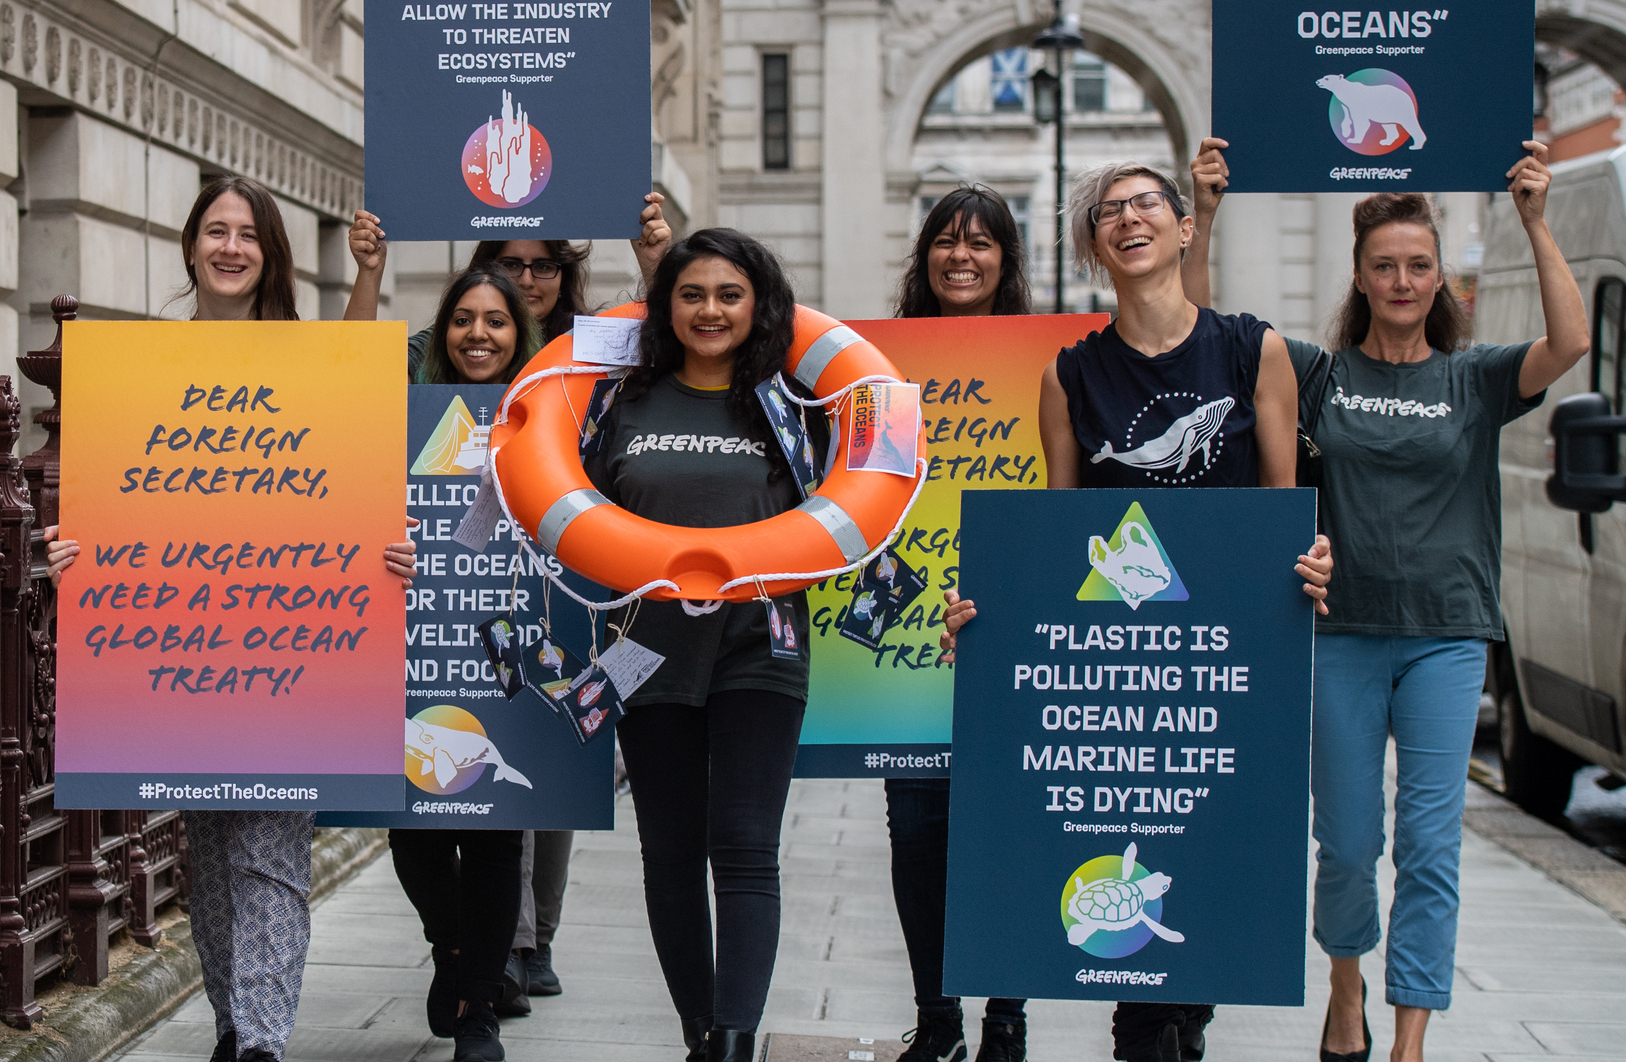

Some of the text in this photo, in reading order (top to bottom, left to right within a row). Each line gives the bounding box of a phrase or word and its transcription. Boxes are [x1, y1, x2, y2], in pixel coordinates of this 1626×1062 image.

[402, 2, 612, 20] ALLOW THE INDUSTRY
[1298, 10, 1448, 38] OCEANS”
[443, 28, 569, 44] TO THREATEN
[438, 51, 575, 69] ECOSYSTEMS”
[1315, 44, 1425, 57] Greenpeace Supporter
[456, 74, 553, 85] Greenpeace Supporter
[1329, 167, 1412, 181] GREENPEACE
[470, 216, 544, 229] GREENPEACE
[180, 384, 281, 413] DEAR
[921, 377, 992, 405] EAR
[1331, 386, 1452, 418] GREENPEACE
[853, 384, 868, 448] THE OCEANS
[869, 384, 882, 429] PROTECT
[145, 424, 311, 459] FOREIGN
[627, 433, 766, 456] GREENPEAC
[925, 416, 1021, 448] REIGN
[119, 466, 329, 500] SECRETARY,
[927, 454, 1038, 485] ETARY,
[407, 485, 480, 506] ILLIO
[406, 519, 452, 541] PLE
[95, 541, 360, 574] WE URGENTLY
[414, 554, 564, 577] HE OCEANS
[79, 582, 370, 617] NEED A STRONG
[406, 588, 529, 611] OR THEIR
[85, 623, 369, 658] GLOBAL OCEAN
[406, 624, 542, 647] VELIHD
[1035, 624, 1229, 651] “PLASTIC IS
[873, 643, 954, 670] TREA
[148, 665, 304, 697] TREATY!
[406, 659, 439, 682] ND
[446, 660, 497, 682] FOO
[1014, 665, 1249, 692] POLLUTING THE
[1042, 705, 1218, 733] OCEAN AND
[864, 752, 952, 769] #ProtectT
[1022, 745, 1236, 774] MARINE LIFE
[138, 783, 318, 800] #ProtectTheOceans
[1045, 786, 1210, 814] IS DYING”
[411, 801, 494, 815] GREENPEACE
[1063, 821, 1186, 836] Greenpeace Supporter
[1075, 968, 1168, 986] GREENPEACE
